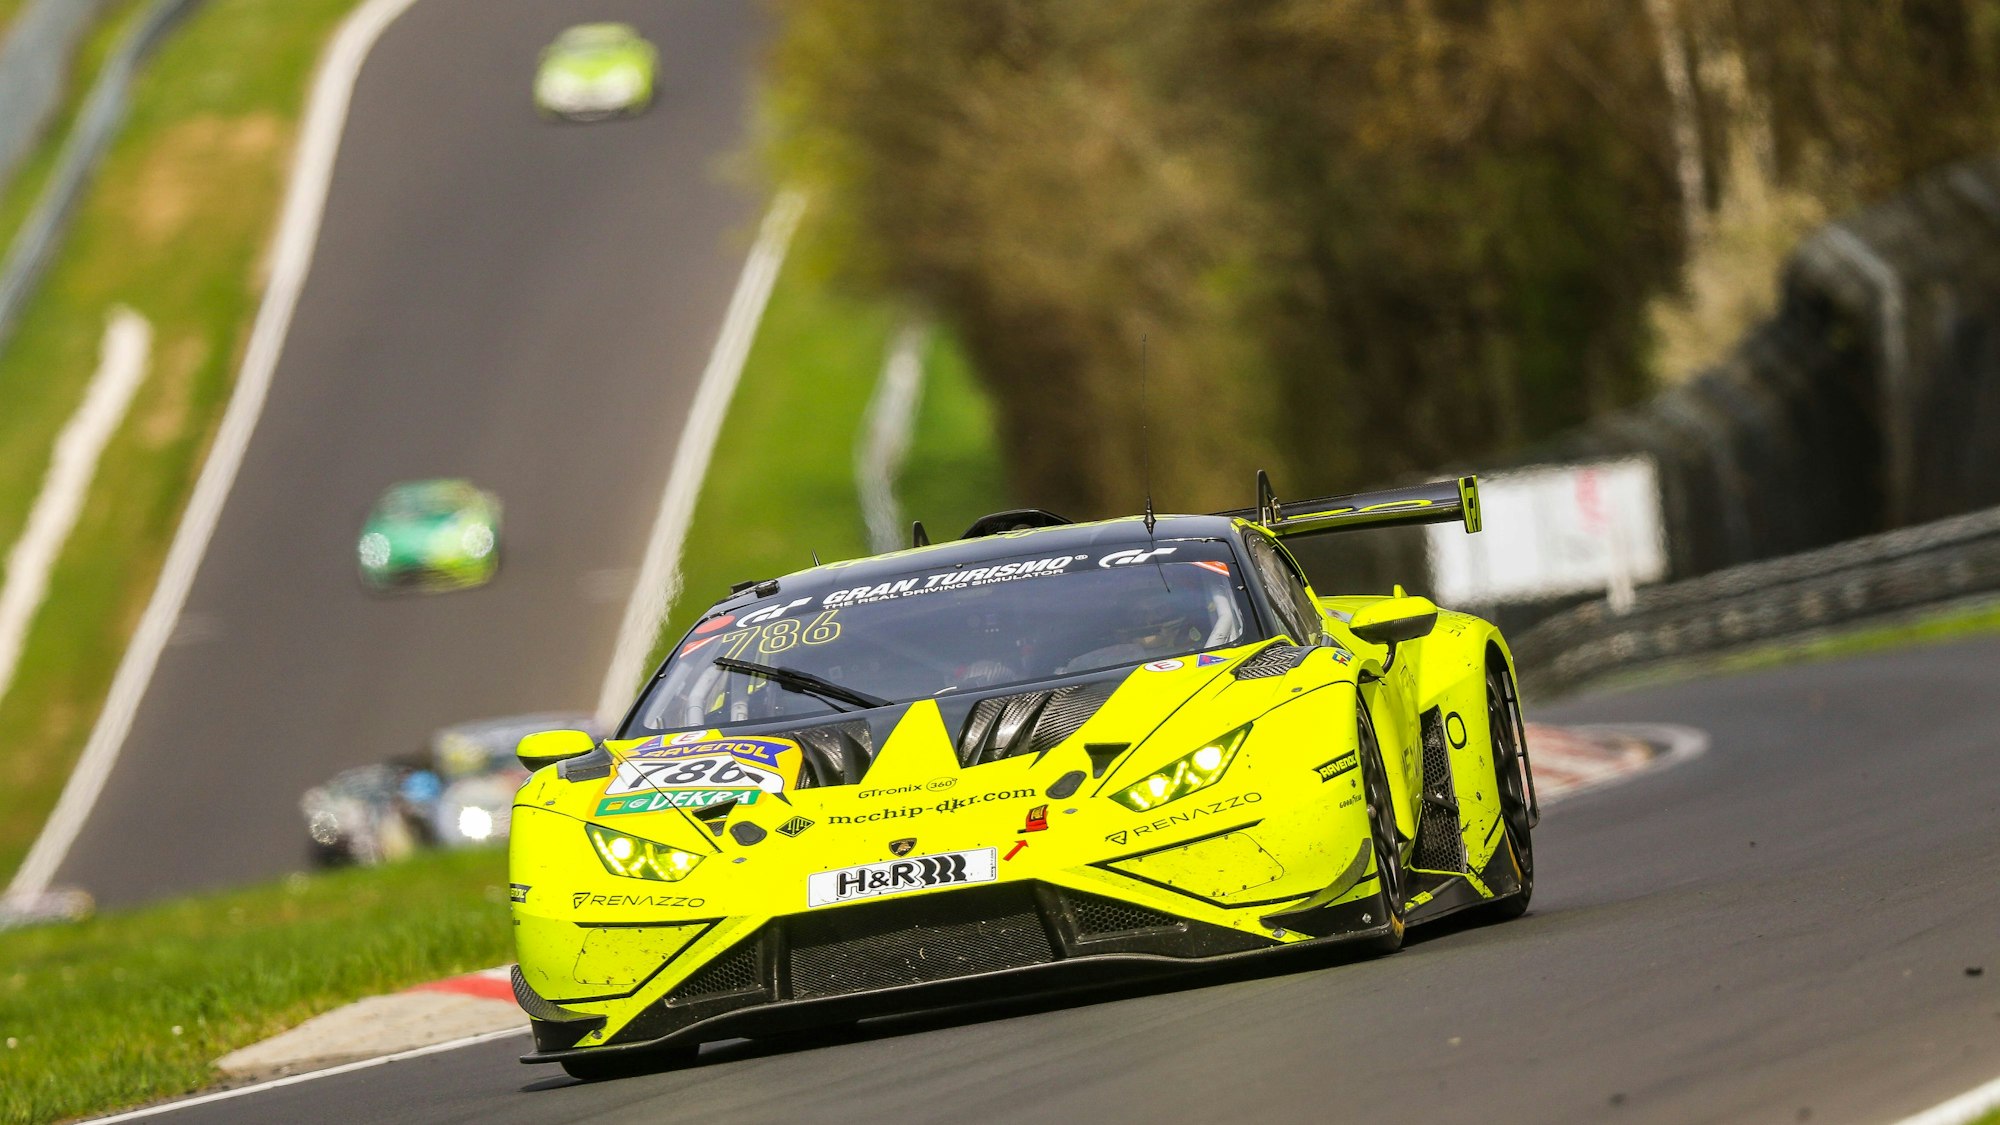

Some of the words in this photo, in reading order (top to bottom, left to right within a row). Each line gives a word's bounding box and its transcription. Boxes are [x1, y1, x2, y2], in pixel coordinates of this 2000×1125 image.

[823, 600, 855, 610] THE
[858, 593, 899, 604] REAL
[902, 582, 968, 597] DRIVING
[971, 569, 1064, 586] SIMULATOR
[823, 578, 920, 605] GRAN
[722, 609, 841, 660] 786
[643, 742, 771, 759] RAVENOL
[628, 759, 765, 790] 786
[646, 791, 752, 811] DEKRA
[828, 788, 1037, 824] mcchip-dkr.com
[858, 783, 923, 799] GTronix
[1133, 792, 1262, 837] RENAZZO
[838, 863, 917, 896] H&R
[590, 895, 706, 908] RENAZZO
